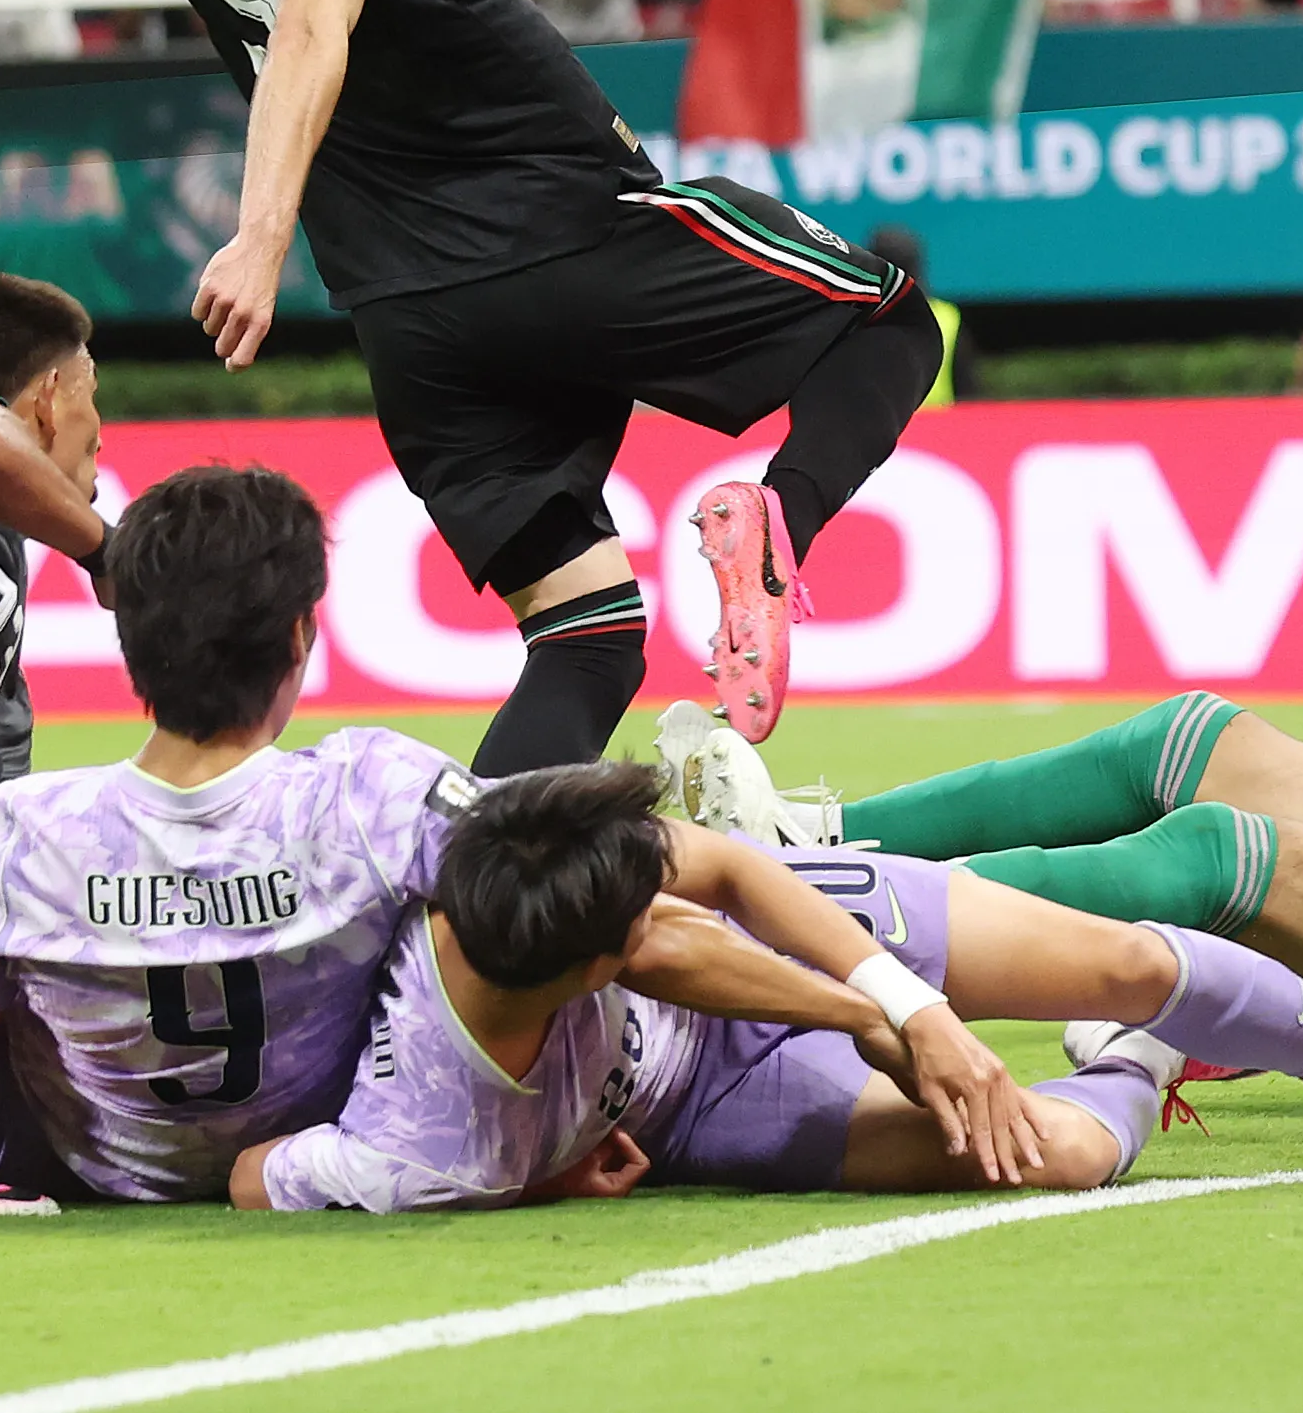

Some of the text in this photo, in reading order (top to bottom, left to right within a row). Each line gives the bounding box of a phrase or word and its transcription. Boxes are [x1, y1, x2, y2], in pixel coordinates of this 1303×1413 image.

[791, 121, 1100, 202] WORLD
[1108, 115, 1288, 198] CUP
[86, 868, 300, 927] GUESUNG
[146, 959, 269, 1106] 9
